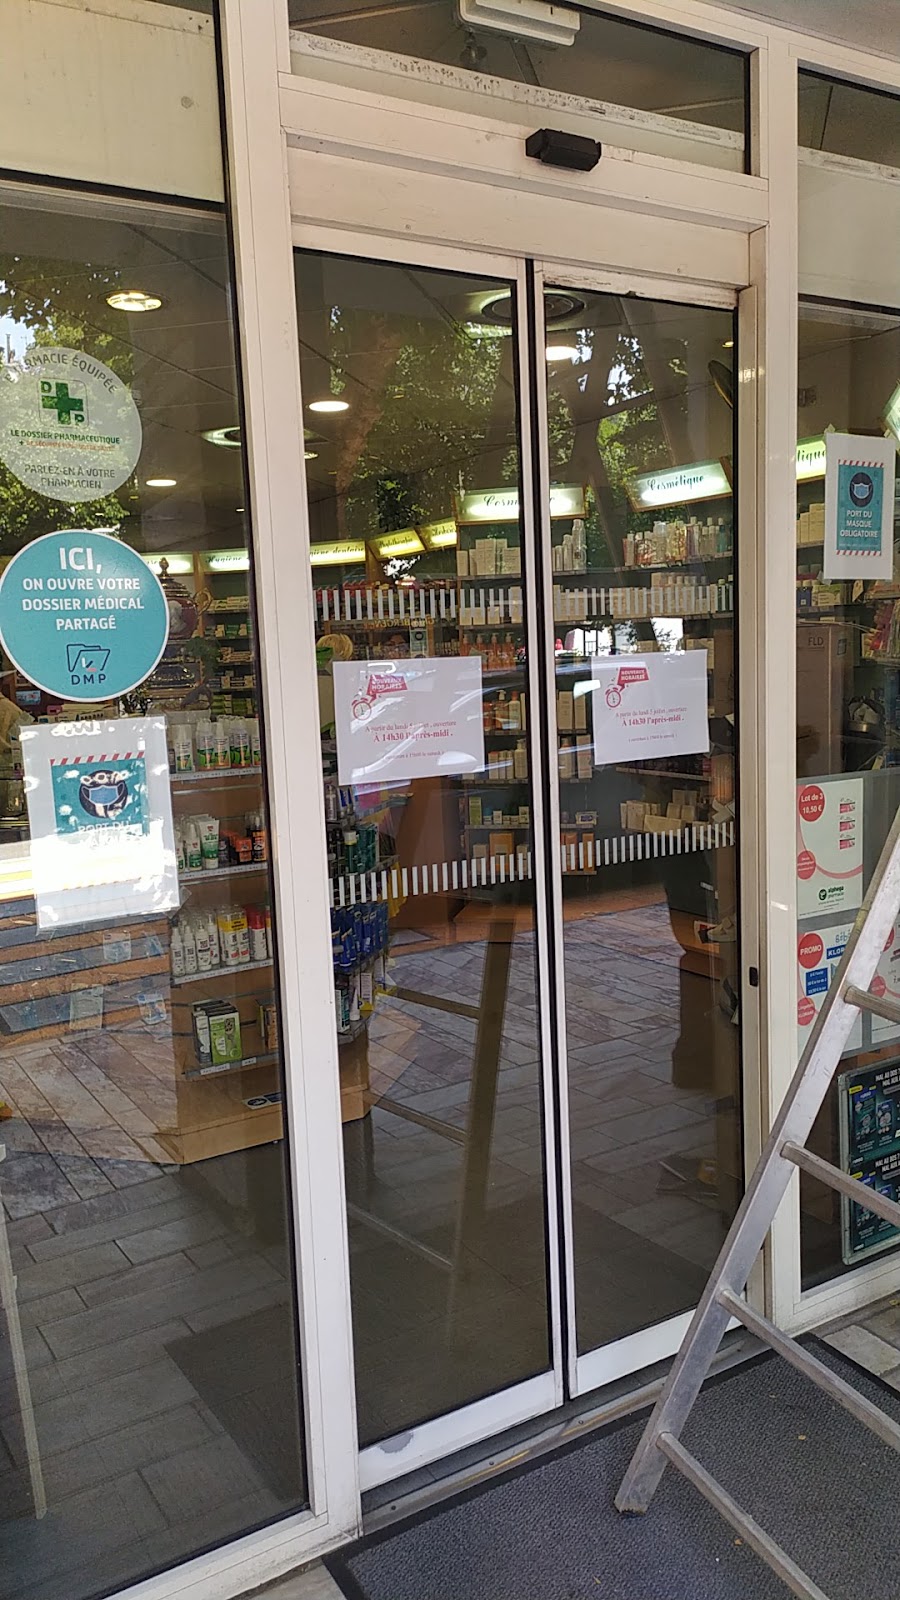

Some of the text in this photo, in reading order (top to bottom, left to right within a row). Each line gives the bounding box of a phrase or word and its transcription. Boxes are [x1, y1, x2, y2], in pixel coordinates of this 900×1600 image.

[72, 354, 118, 394] ÉQUIPÉE
[10, 429, 120, 445] LE DOSSIER PHARMACEUTIQUE
[25, 464, 116, 478] PARLEZ-EN À VOTRE
[41, 477, 102, 489] PHARMACIEN
[646, 474, 704, 490] Cosmétique
[846, 509, 873, 518] PORT DU
[846, 519, 872, 528] MASQUE
[839, 529, 879, 538] OBLIGATOIRE
[59, 547, 102, 574] ICI,
[22, 577, 141, 591] ON OUVRE VOTRE
[22, 595, 145, 611] DOSSIER MÉDICAL
[56, 614, 117, 630] PARTAGÉ
[71, 673, 107, 686] DMP
[628, 717, 646, 726] 14h30
[373, 732, 380, 742] À
[382, 731, 404, 741] 14h30
[800, 794, 811, 803] Lot
[811, 793, 819, 801] de
[799, 944, 822, 956] PROMO
[828, 947, 845, 957] KLOR
[875, 1073, 884, 1082] MAL
[890, 1069, 898, 1077] DOS
[882, 1078, 891, 1087] MAL
[875, 1159, 884, 1168] MAL
[890, 1154, 898, 1162] DOS
[882, 1164, 890, 1172] MAL
